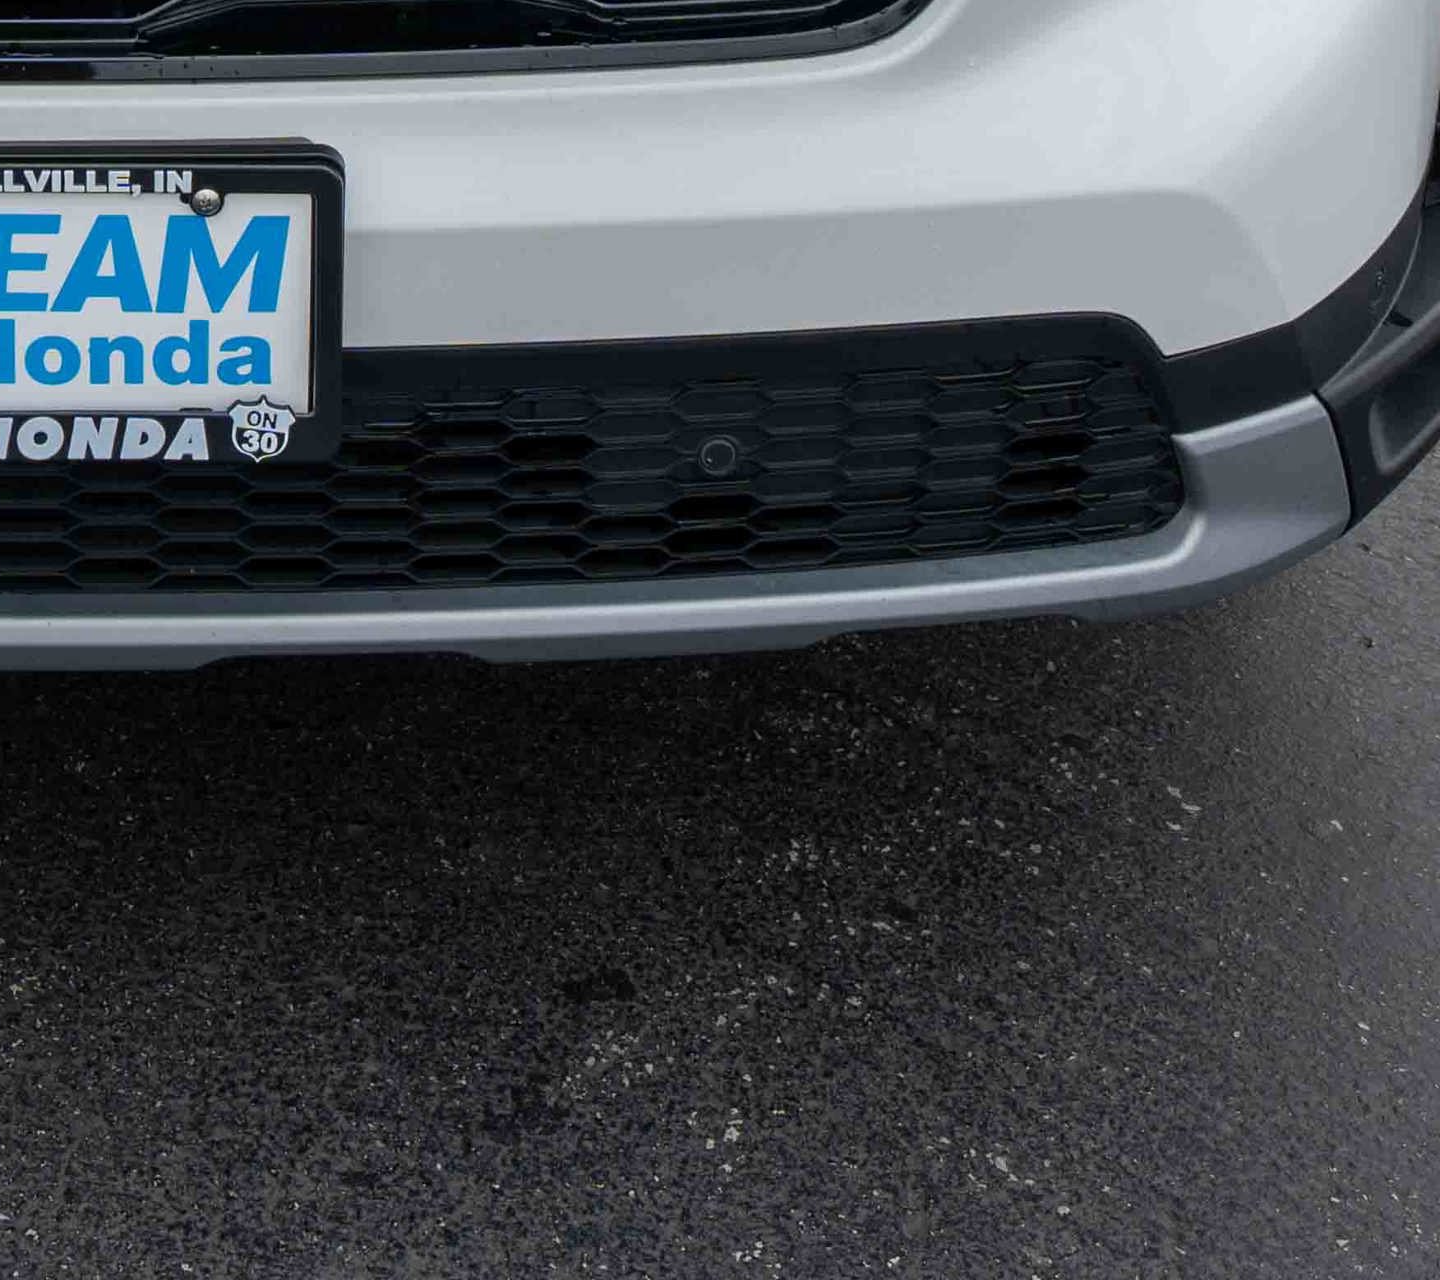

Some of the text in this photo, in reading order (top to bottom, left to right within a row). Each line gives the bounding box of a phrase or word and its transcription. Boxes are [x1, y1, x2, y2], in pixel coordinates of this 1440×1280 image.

[153, 170, 193, 194] IN
[246, 410, 278, 430] ON
[241, 429, 278, 454] 30
